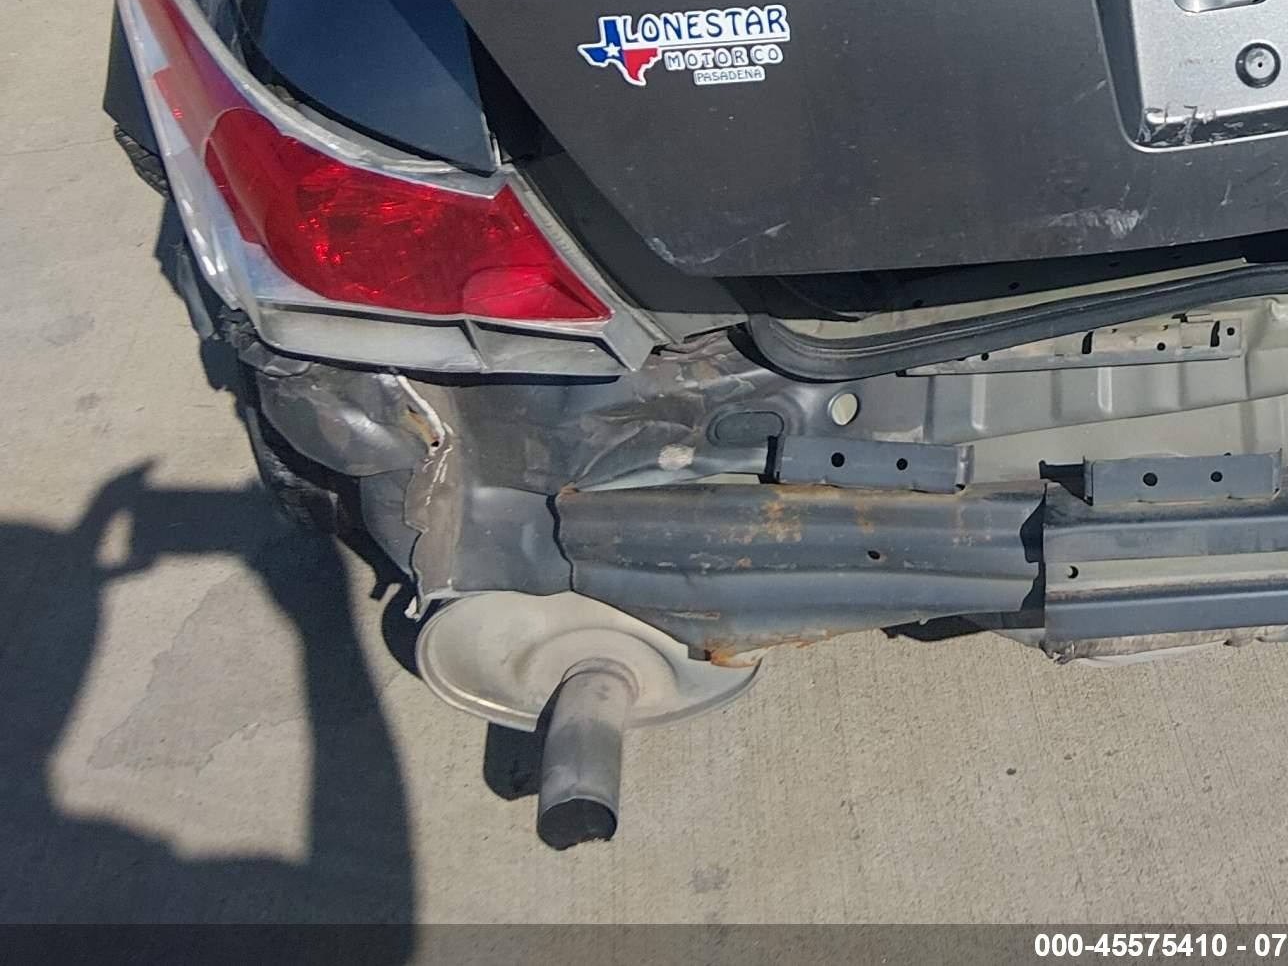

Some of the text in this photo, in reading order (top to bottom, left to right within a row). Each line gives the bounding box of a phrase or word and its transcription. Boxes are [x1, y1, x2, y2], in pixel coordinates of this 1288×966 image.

[622, 7, 787, 43] LONESTAR
[666, 50, 747, 69] MOTOR
[695, 68, 763, 84] PASADENA
